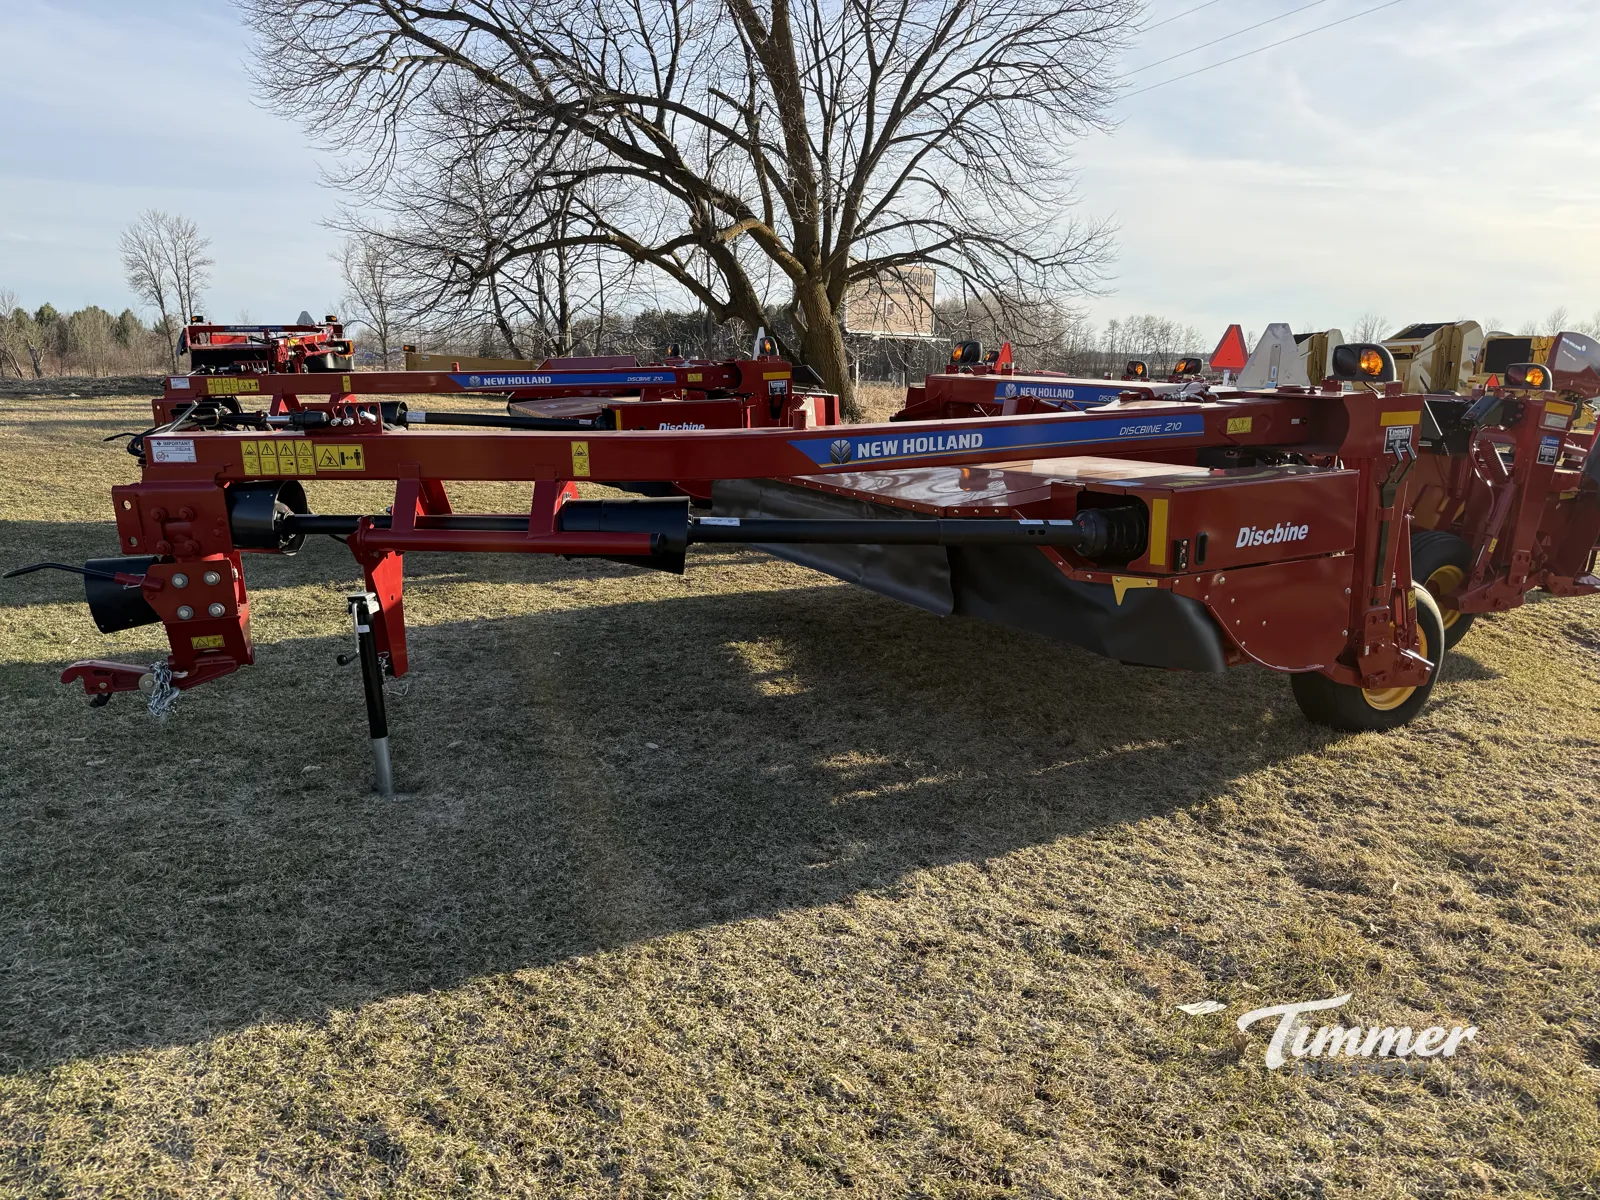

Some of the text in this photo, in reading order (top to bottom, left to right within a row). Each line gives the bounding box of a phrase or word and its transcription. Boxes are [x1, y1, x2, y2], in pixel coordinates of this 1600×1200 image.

[483, 376, 552, 386] NEW HOLLAND
[1020, 386, 1075, 399] NEW HOLLAND
[1099, 394, 1121, 402] DISCB
[1119, 421, 1183, 436] DISCBINE 210
[857, 433, 983, 459] NEW HOLLAND
[1235, 521, 1309, 549] Discbine
